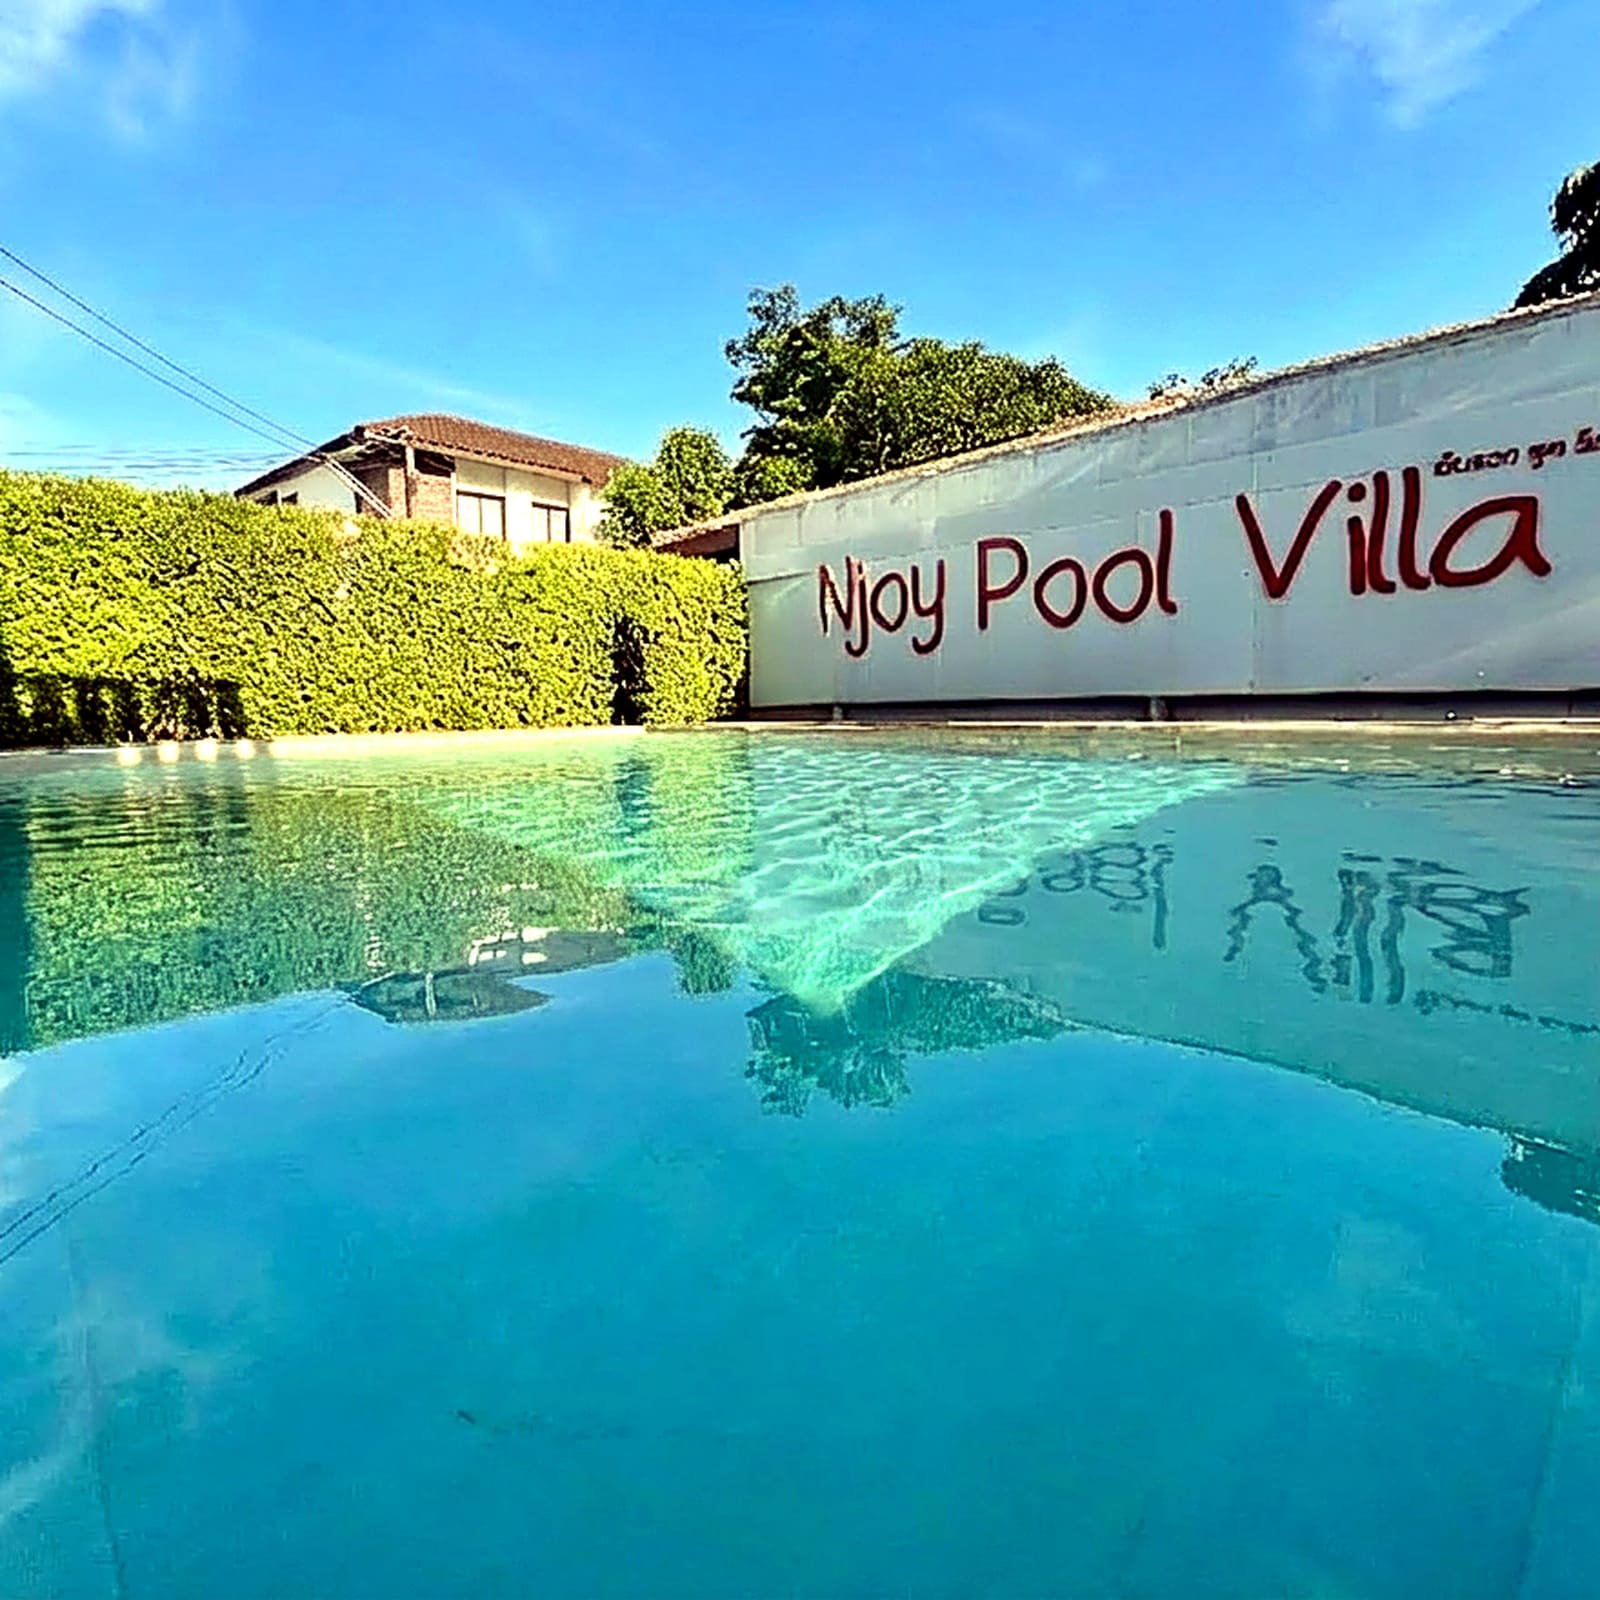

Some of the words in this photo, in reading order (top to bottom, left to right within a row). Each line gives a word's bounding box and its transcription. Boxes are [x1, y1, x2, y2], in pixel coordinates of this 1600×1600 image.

[818, 555, 945, 659] Njoy
[977, 508, 1178, 631] Pool
[1235, 465, 1553, 600] Villa
